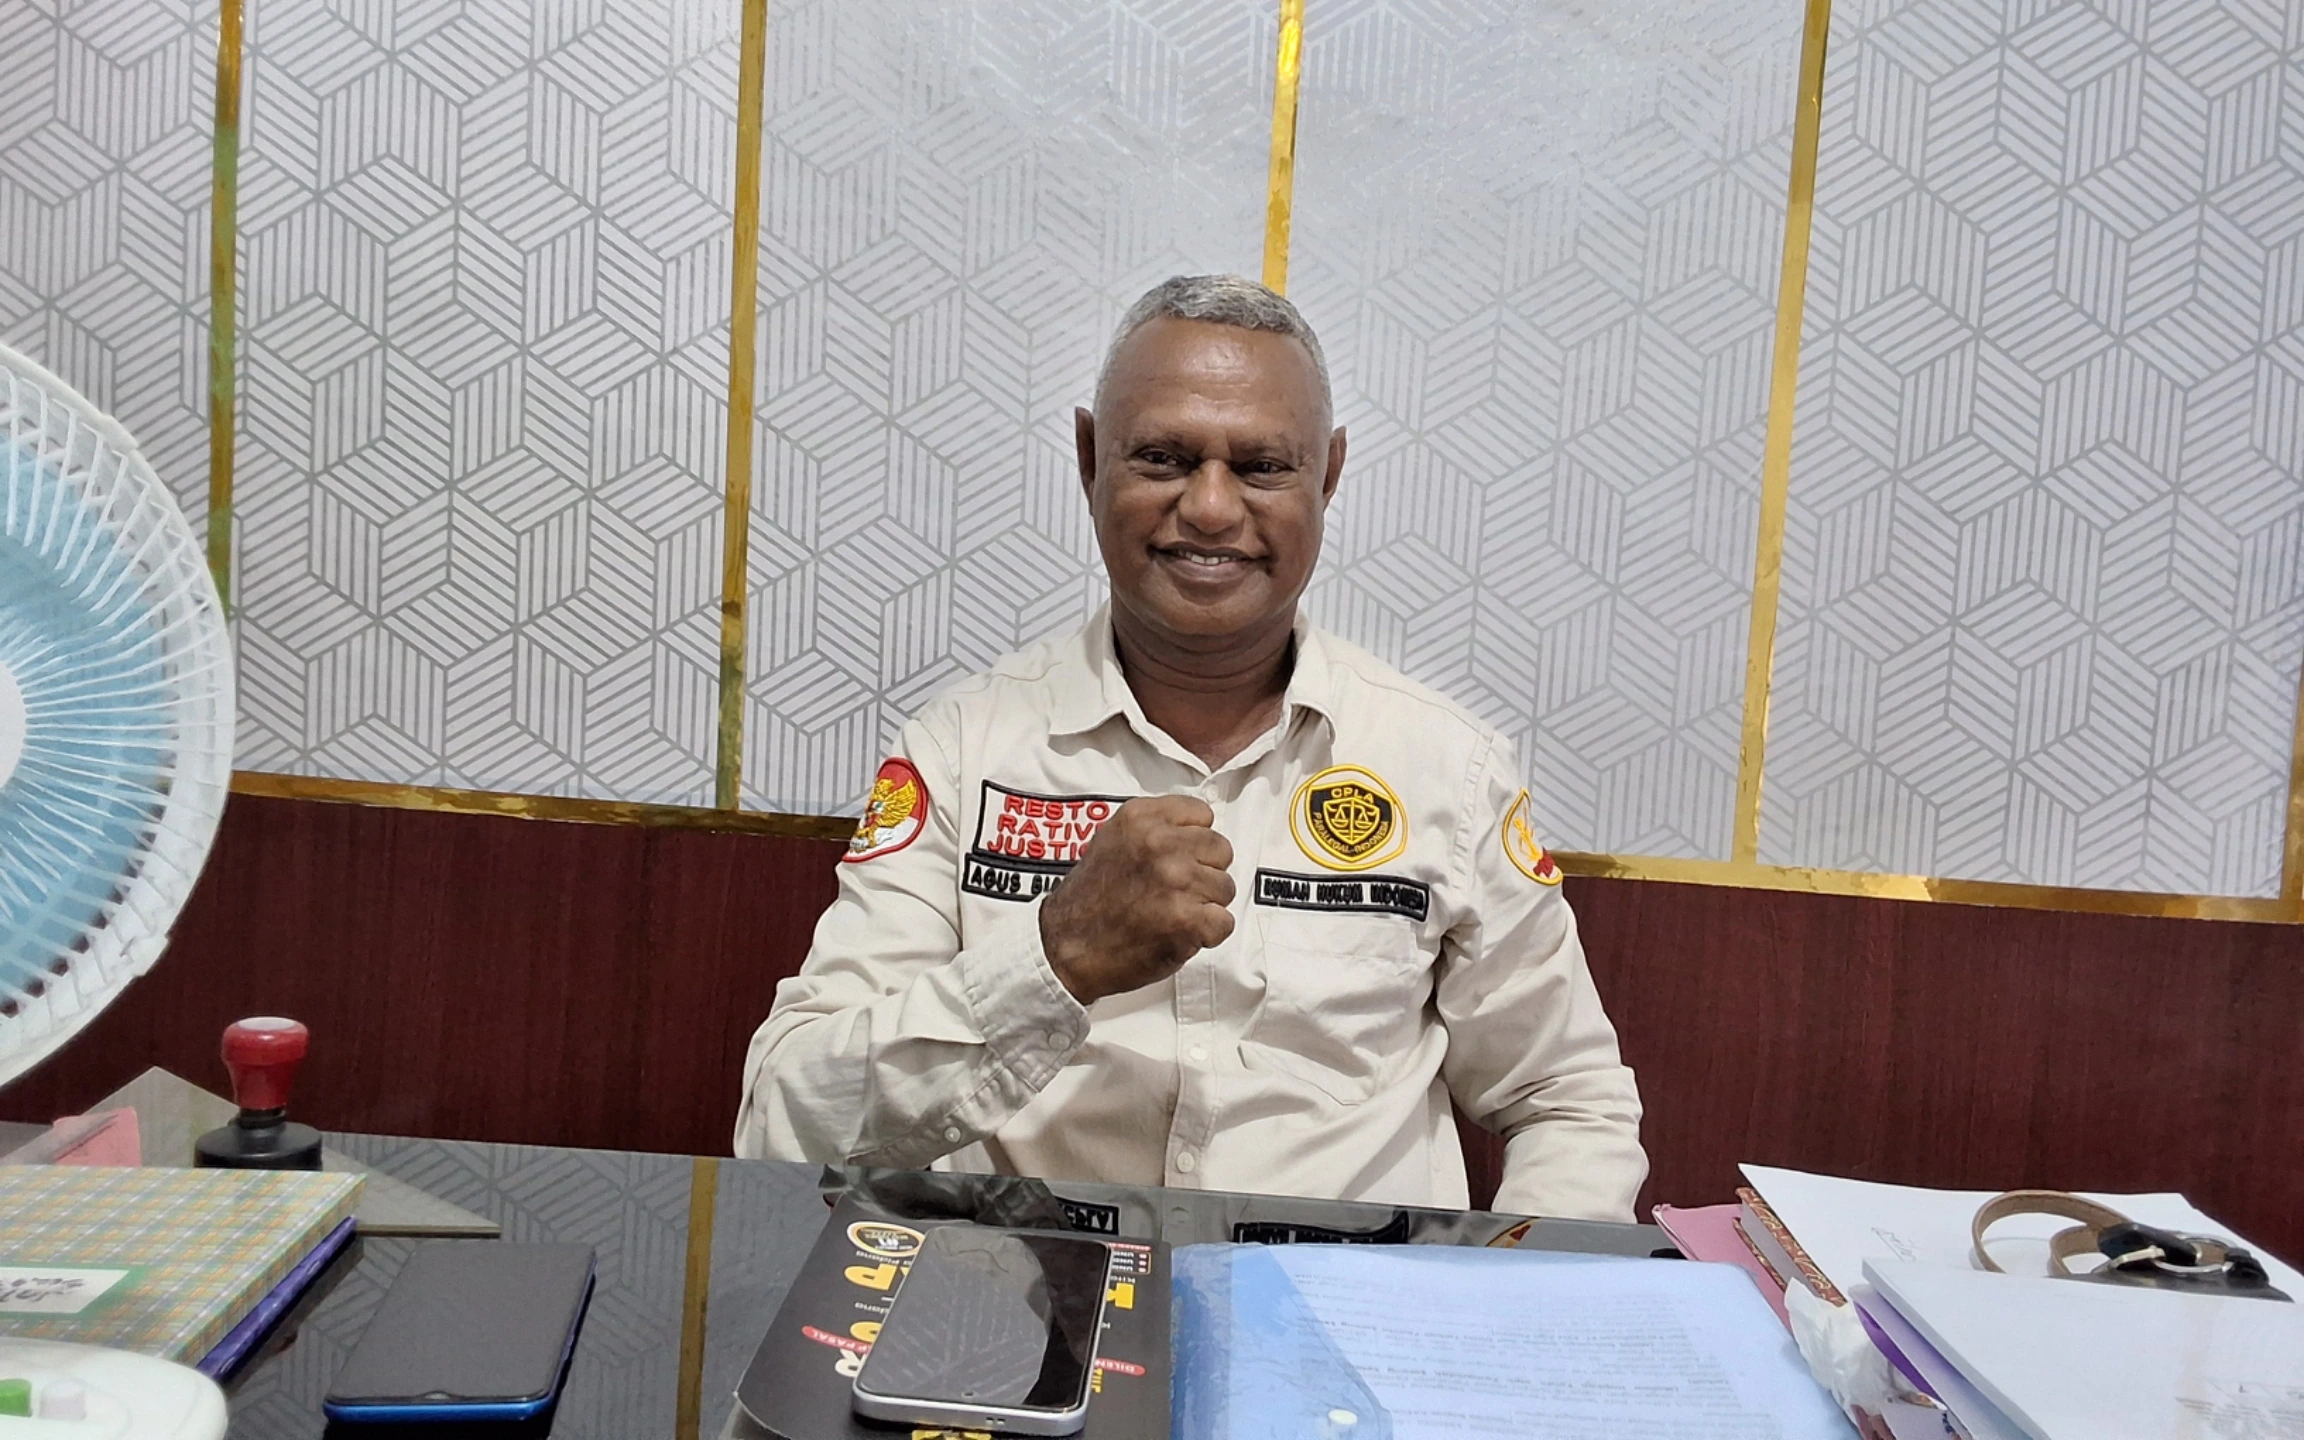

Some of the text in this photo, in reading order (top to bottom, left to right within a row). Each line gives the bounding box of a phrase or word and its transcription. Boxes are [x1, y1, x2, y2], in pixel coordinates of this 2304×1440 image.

[1004, 795, 1110, 820] RESTO
[1331, 787, 1375, 804] CPLA
[997, 814, 1106, 841] RATIV
[987, 834, 1091, 861] JUSTI
[970, 866, 1021, 893] AGUS
